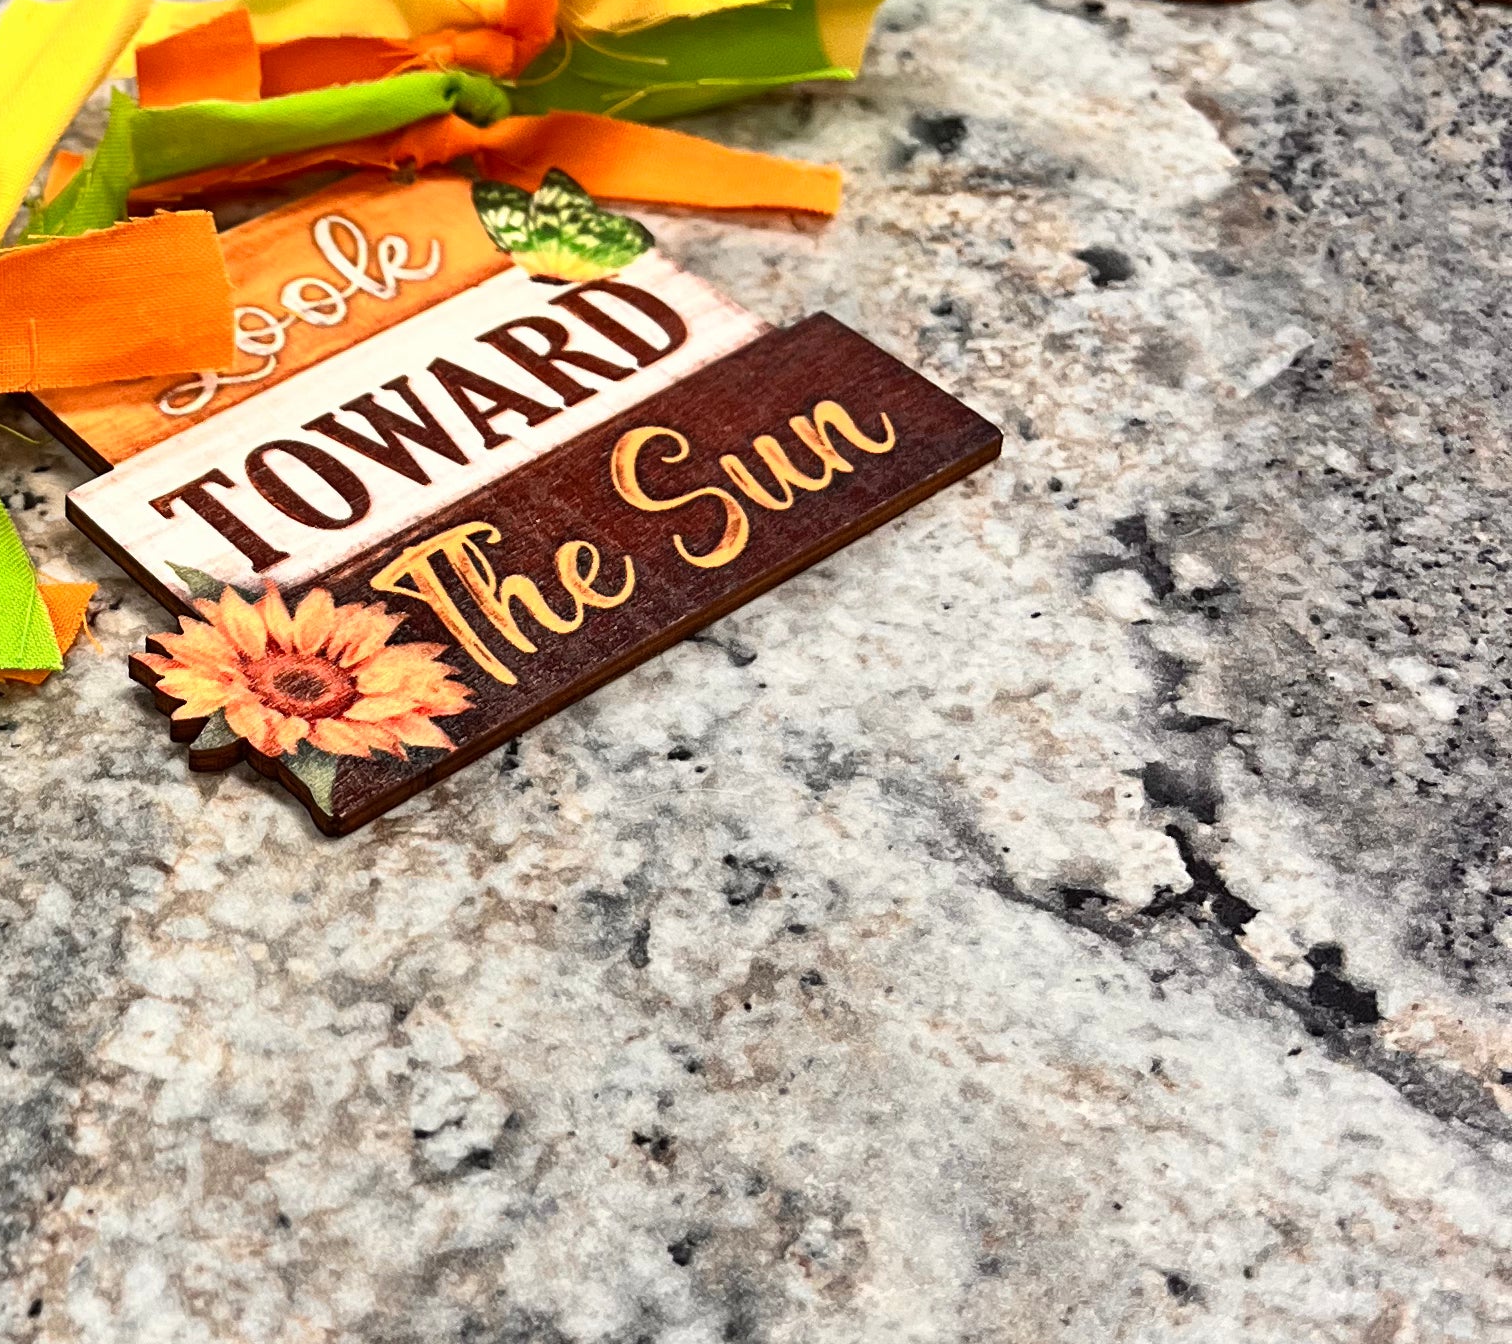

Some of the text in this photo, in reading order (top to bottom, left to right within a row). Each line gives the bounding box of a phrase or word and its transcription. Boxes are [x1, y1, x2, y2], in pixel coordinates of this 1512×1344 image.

[149, 278, 688, 573] TOWARD
[371, 399, 896, 686] The Sun
